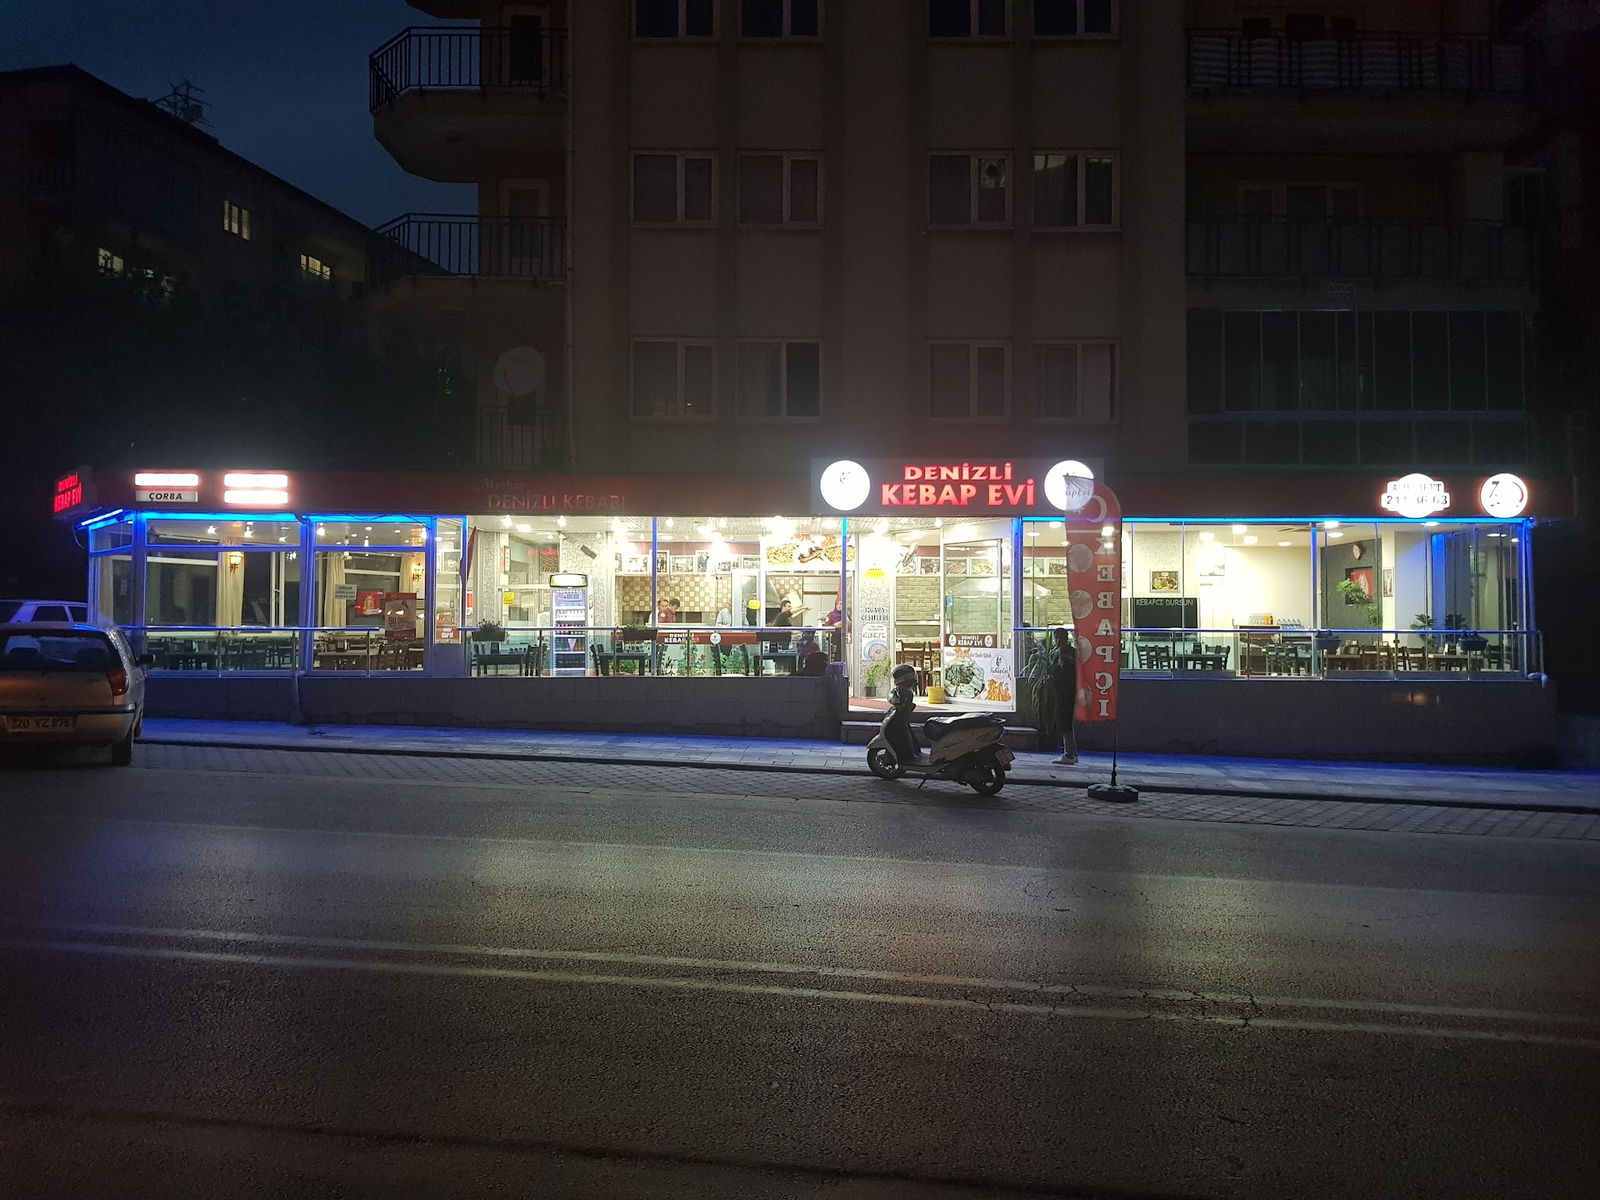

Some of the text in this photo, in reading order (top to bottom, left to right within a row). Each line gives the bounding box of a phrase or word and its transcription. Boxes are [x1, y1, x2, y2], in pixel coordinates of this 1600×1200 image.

[904, 462, 1012, 481] DENİZLİ
[148, 492, 183, 502] ÇORBA
[881, 477, 1036, 506] KEBAP EVİ
[1165, 598, 1193, 606] DURSUN
